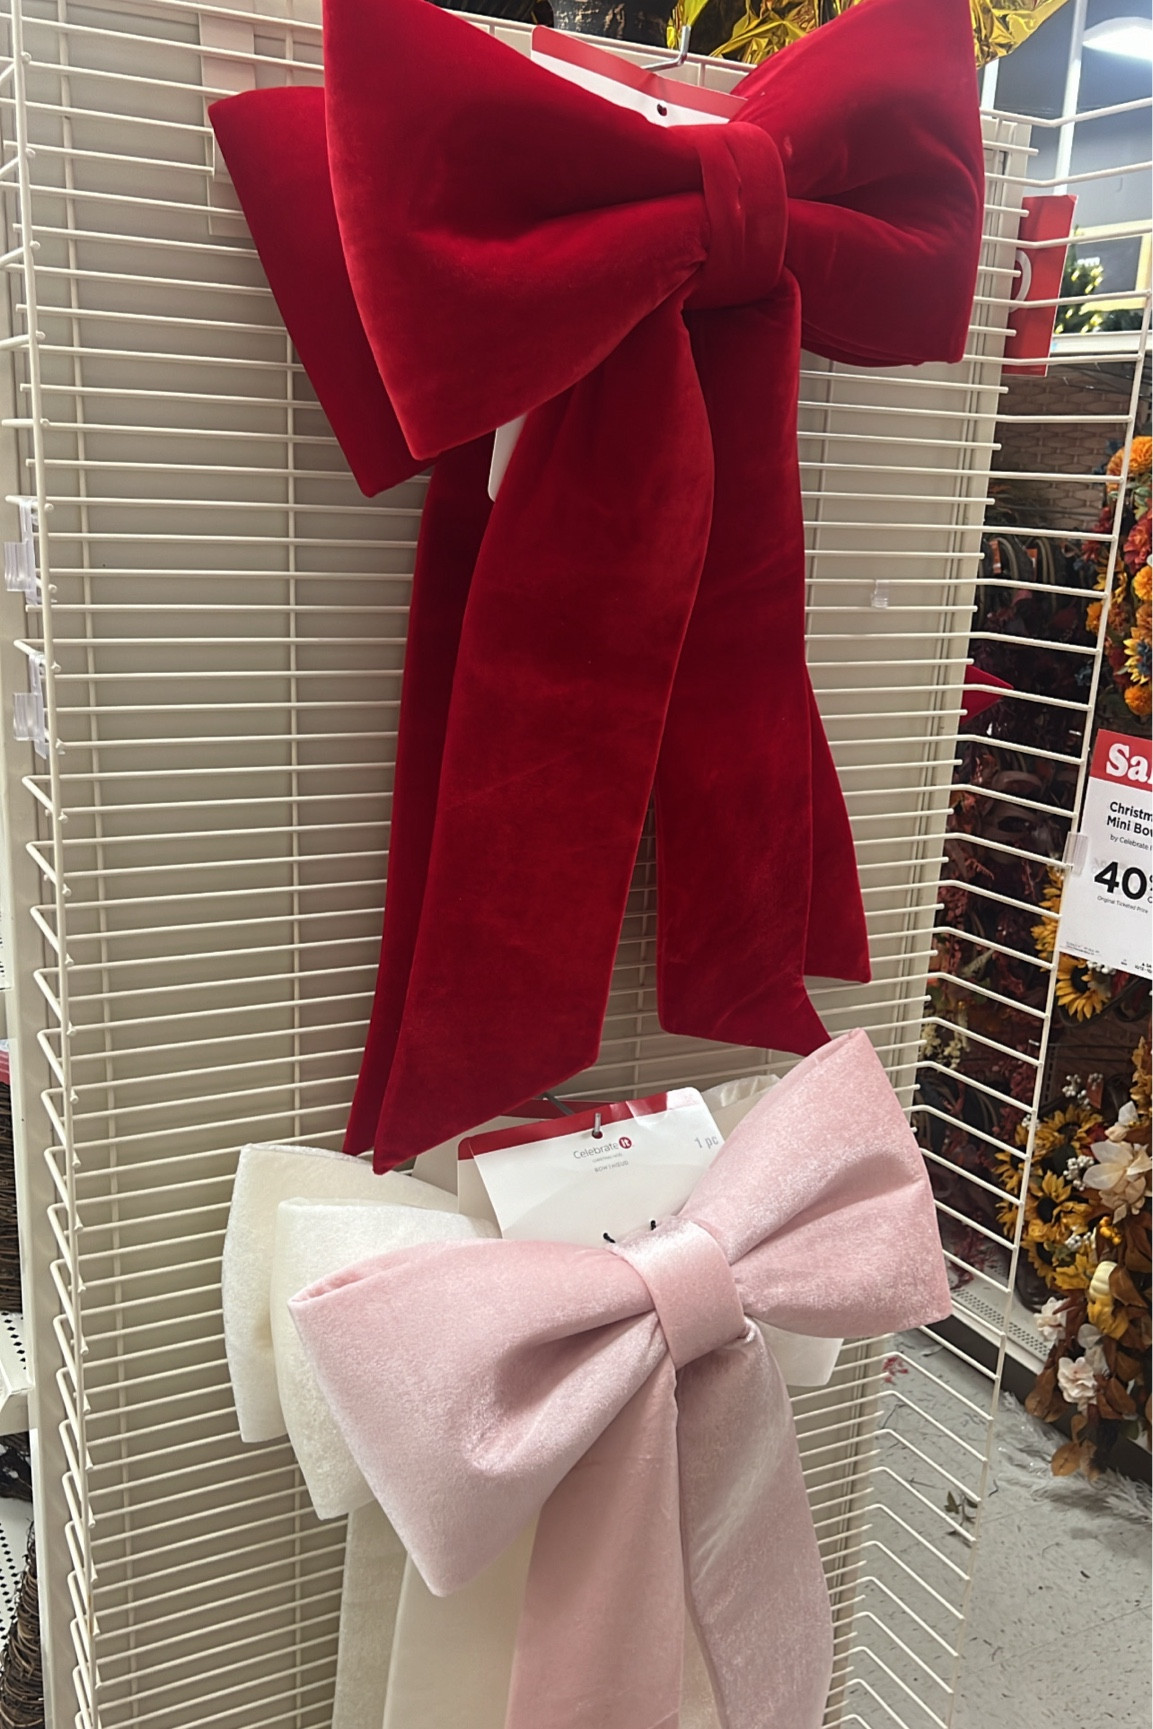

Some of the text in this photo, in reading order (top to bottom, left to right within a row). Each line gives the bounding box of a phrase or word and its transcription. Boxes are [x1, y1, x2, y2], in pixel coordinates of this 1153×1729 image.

[1105, 743, 1152, 784] Sa
[1107, 815, 1131, 831] Mini
[1110, 834, 1118, 843] by
[1119, 836, 1149, 850] Celebrate
[1097, 895, 1148, 914] Original Ticketed Price
[694, 1135, 719, 1149] 1 pc
[573, 1142, 619, 1159] Celebrate
[594, 1164, 608, 1173] BOW
